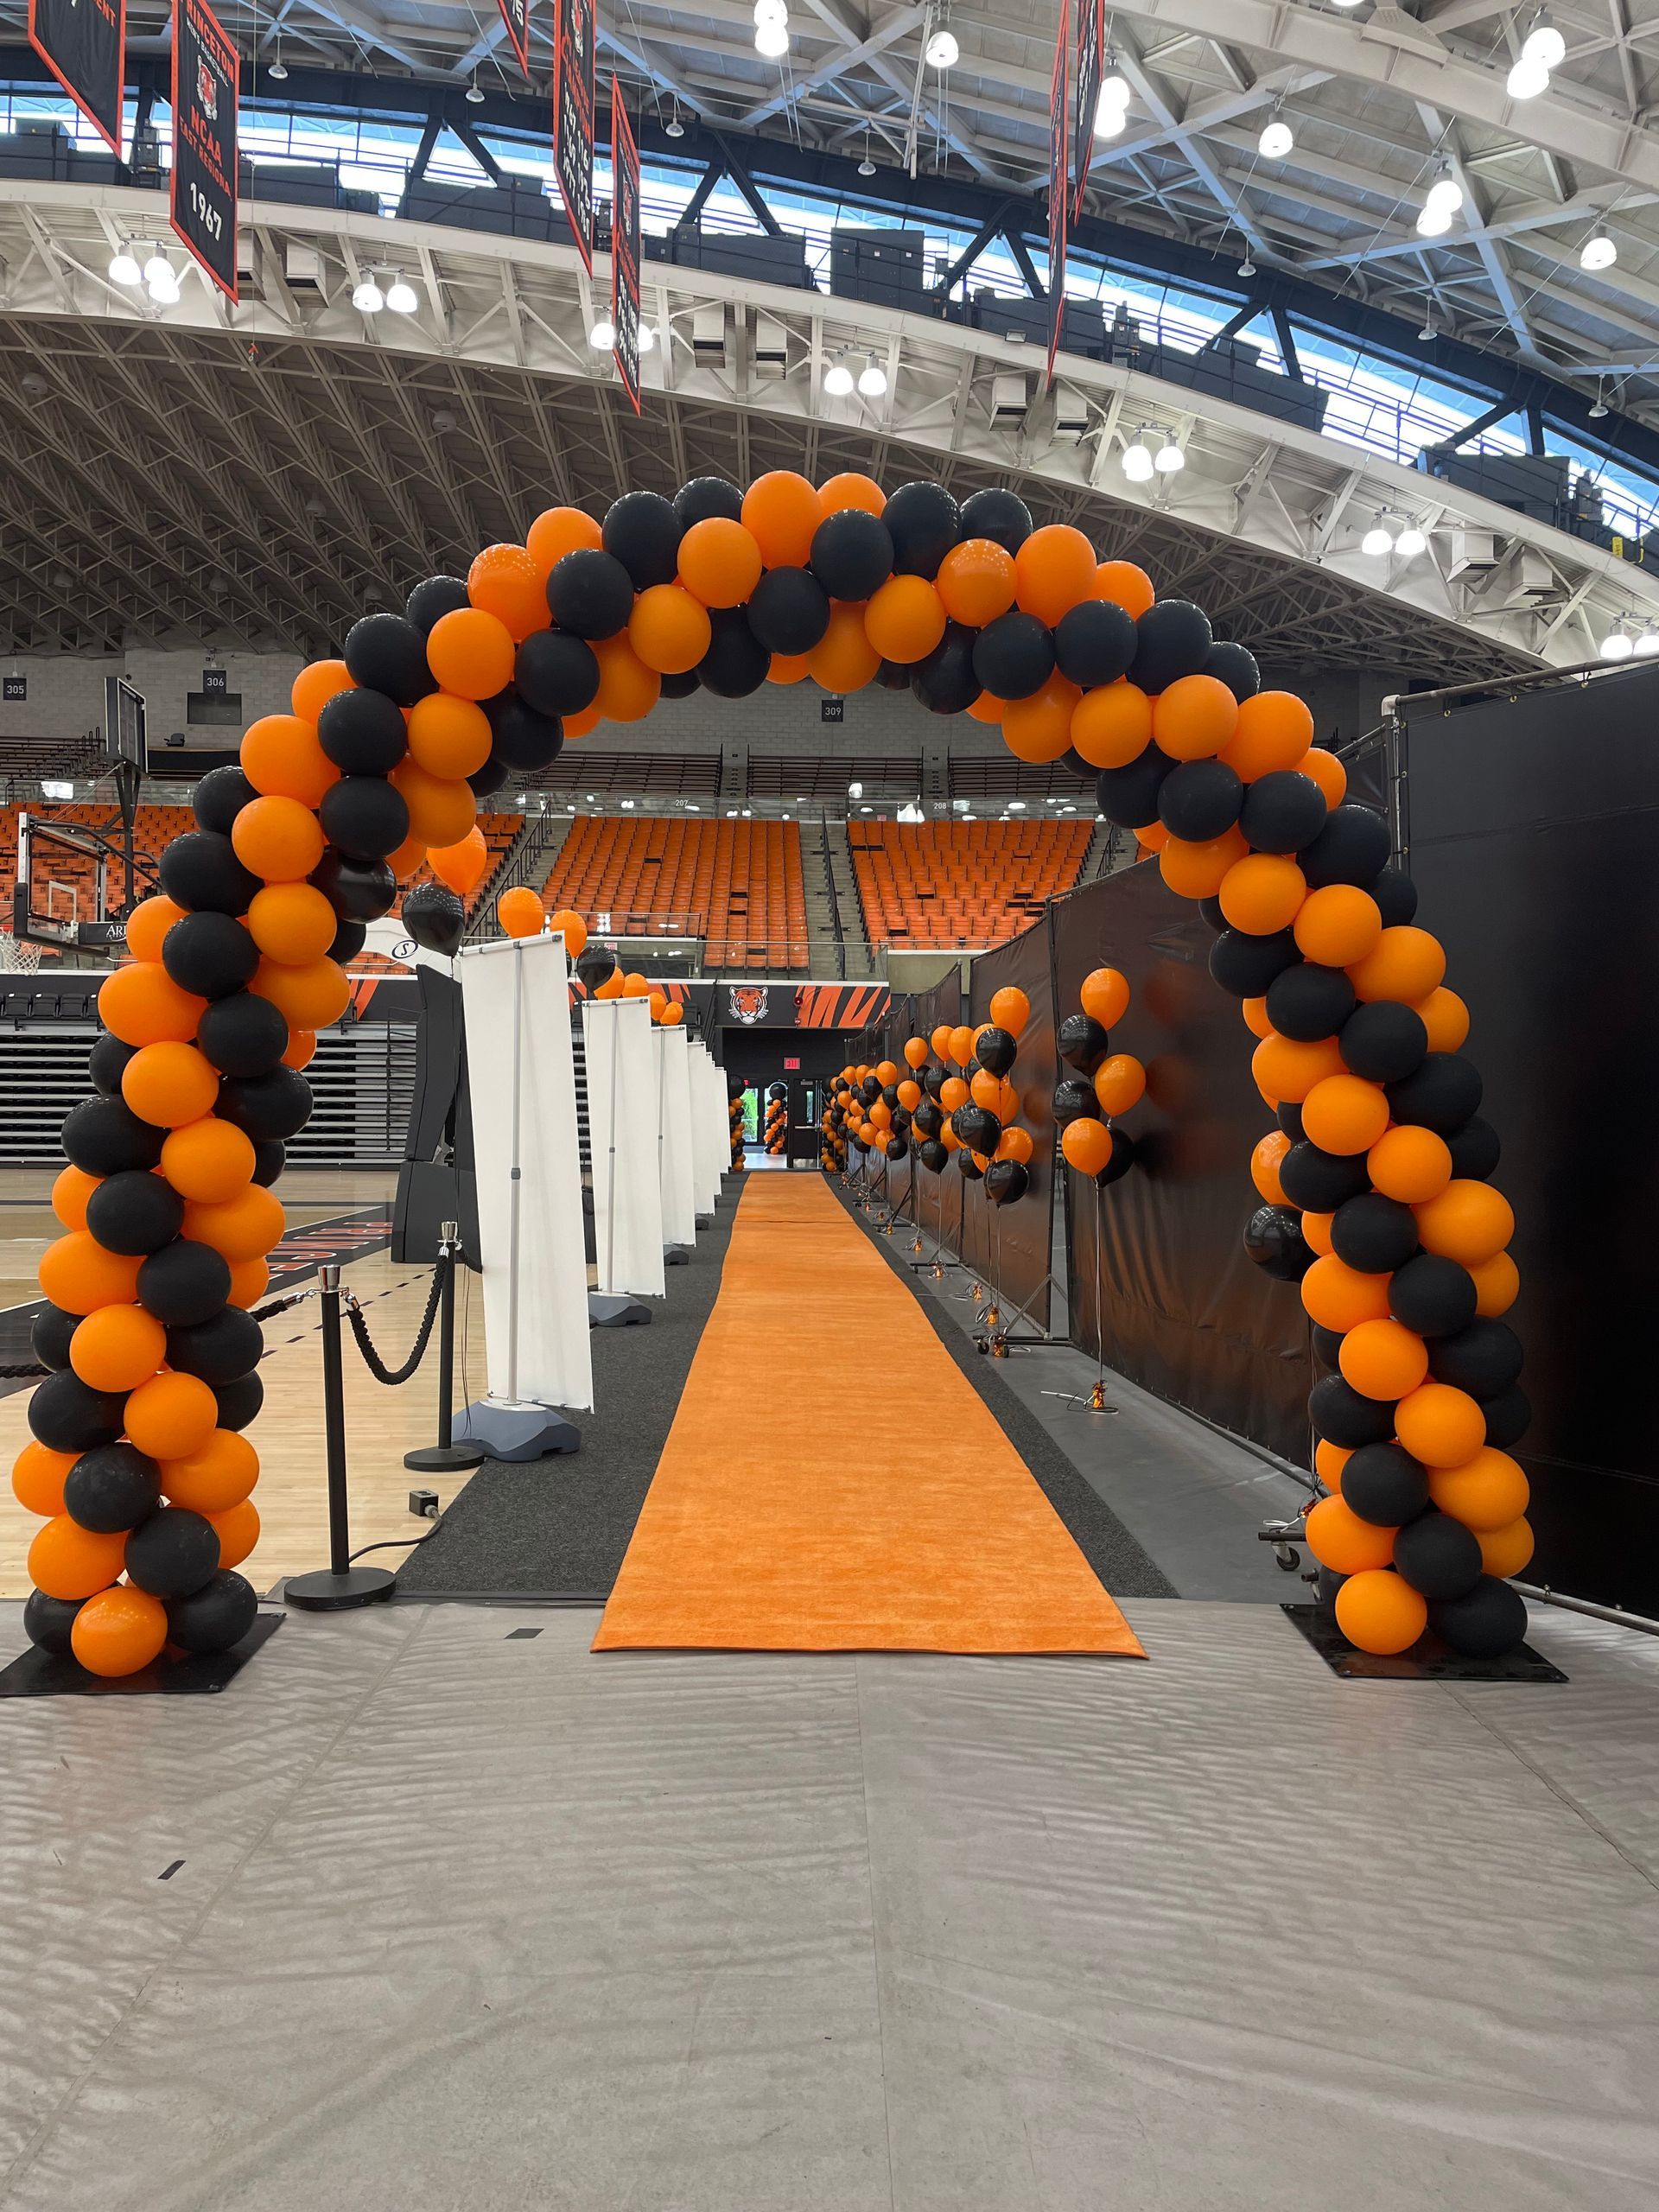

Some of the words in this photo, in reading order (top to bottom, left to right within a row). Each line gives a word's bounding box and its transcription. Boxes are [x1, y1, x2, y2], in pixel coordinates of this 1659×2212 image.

[181, 0, 234, 83] RINCETON
[179, 115, 198, 152] EAST
[199, 144, 232, 201] REGIONA
[190, 105, 223, 168] NCAA
[190, 182, 222, 241] 1967
[7, 685, 24, 695] 305
[207, 677, 225, 687] 306
[825, 707, 842, 716] 309
